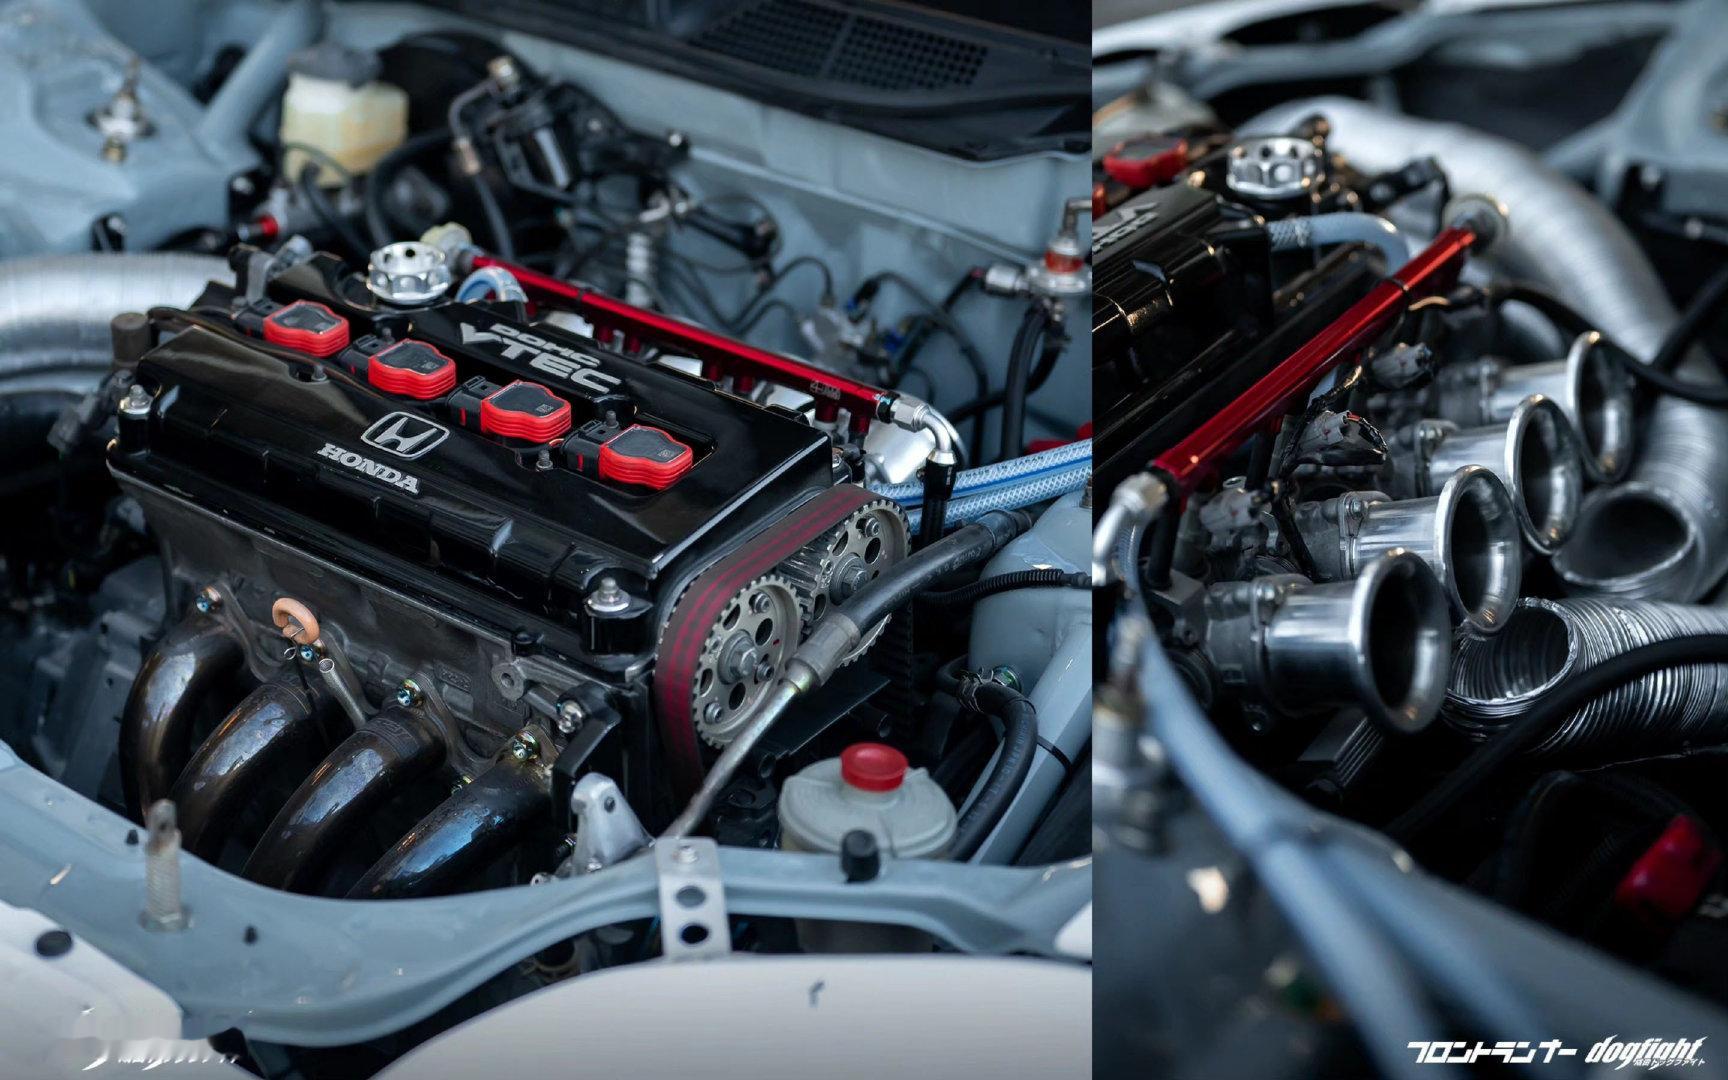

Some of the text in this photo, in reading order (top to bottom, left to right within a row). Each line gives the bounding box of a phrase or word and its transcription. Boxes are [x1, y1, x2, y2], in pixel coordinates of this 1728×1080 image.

[459, 322, 622, 394] VTEC
[489, 323, 601, 368] DOHC
[317, 442, 419, 494] HONDA
